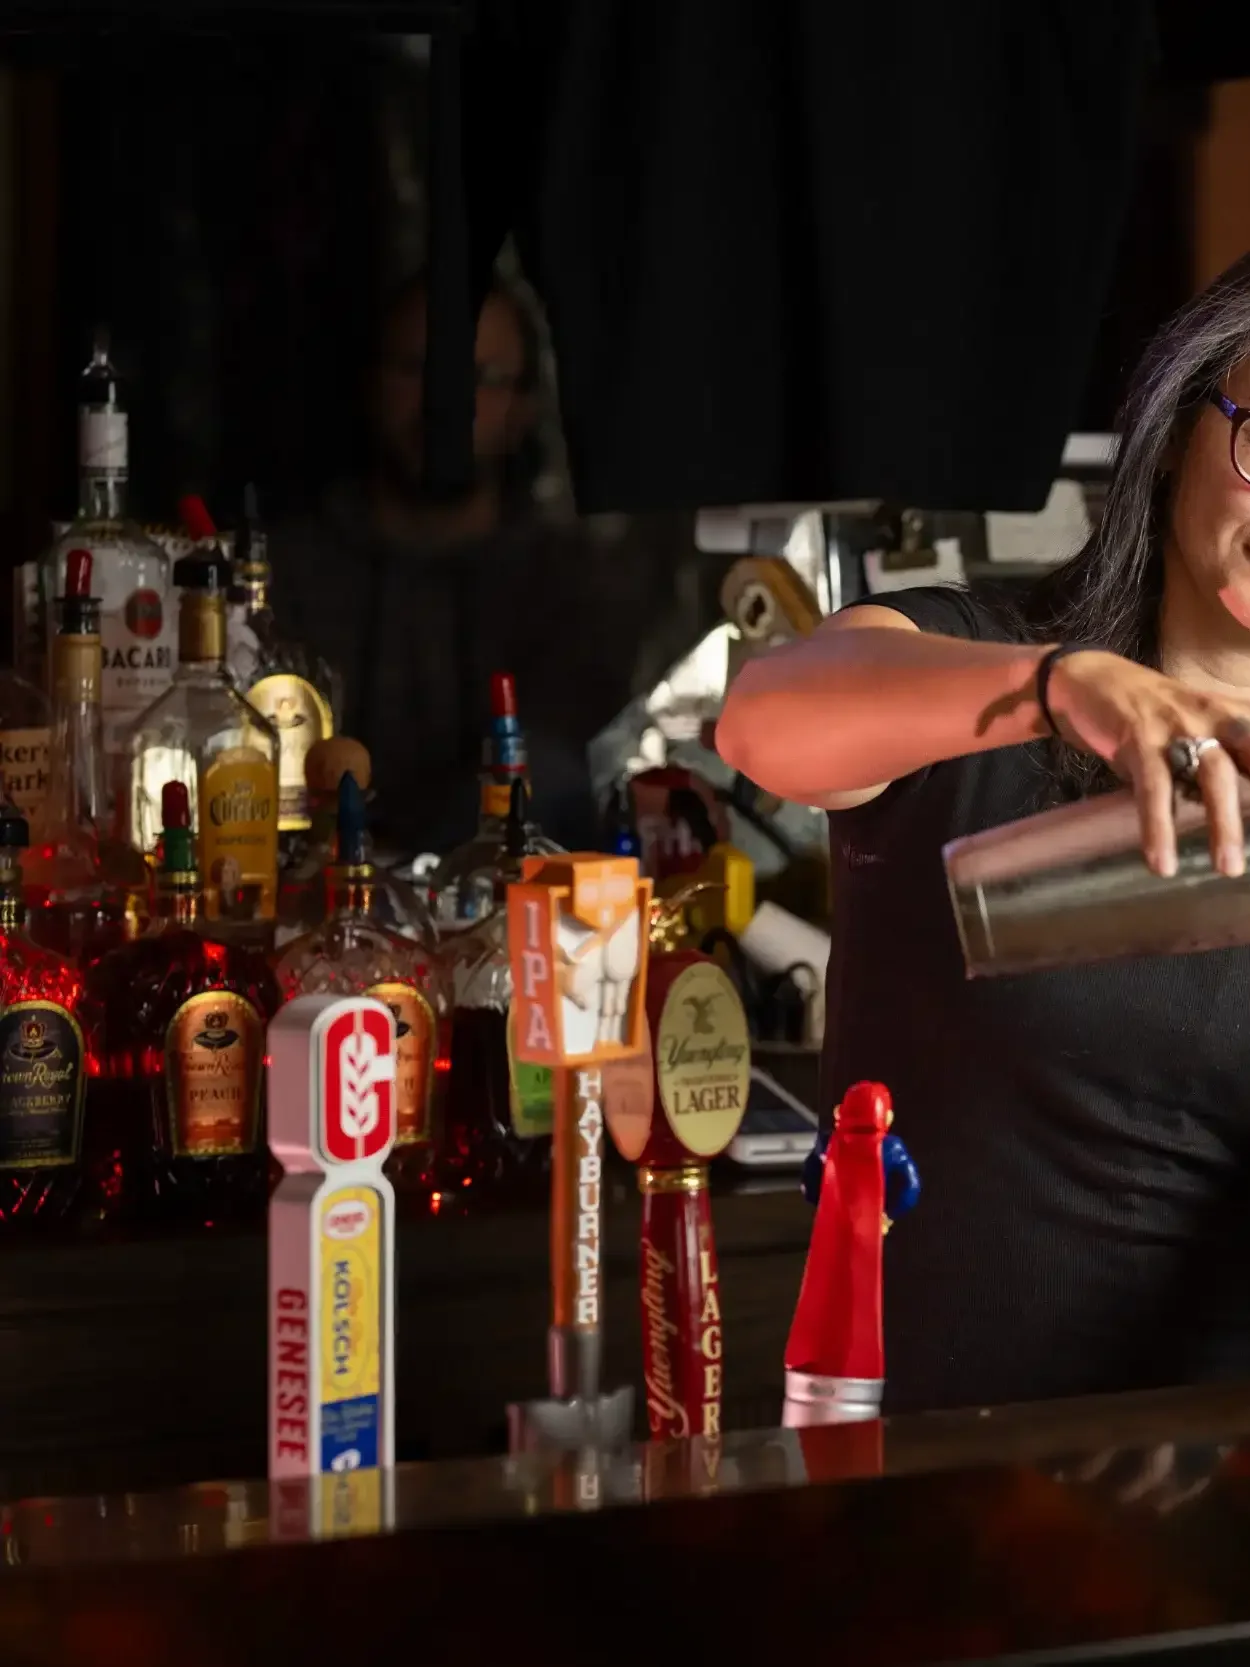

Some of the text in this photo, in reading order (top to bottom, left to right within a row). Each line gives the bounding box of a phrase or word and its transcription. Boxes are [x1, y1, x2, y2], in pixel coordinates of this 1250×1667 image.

[522, 901, 554, 1051] IPA
[672, 1084, 741, 1116] LAGER
[577, 1071, 602, 1325] HAYBURNER
[275, 1287, 309, 1465] GENESEE
[641, 1237, 690, 1440] Yuengling
[699, 1250, 723, 1436] LAGER
